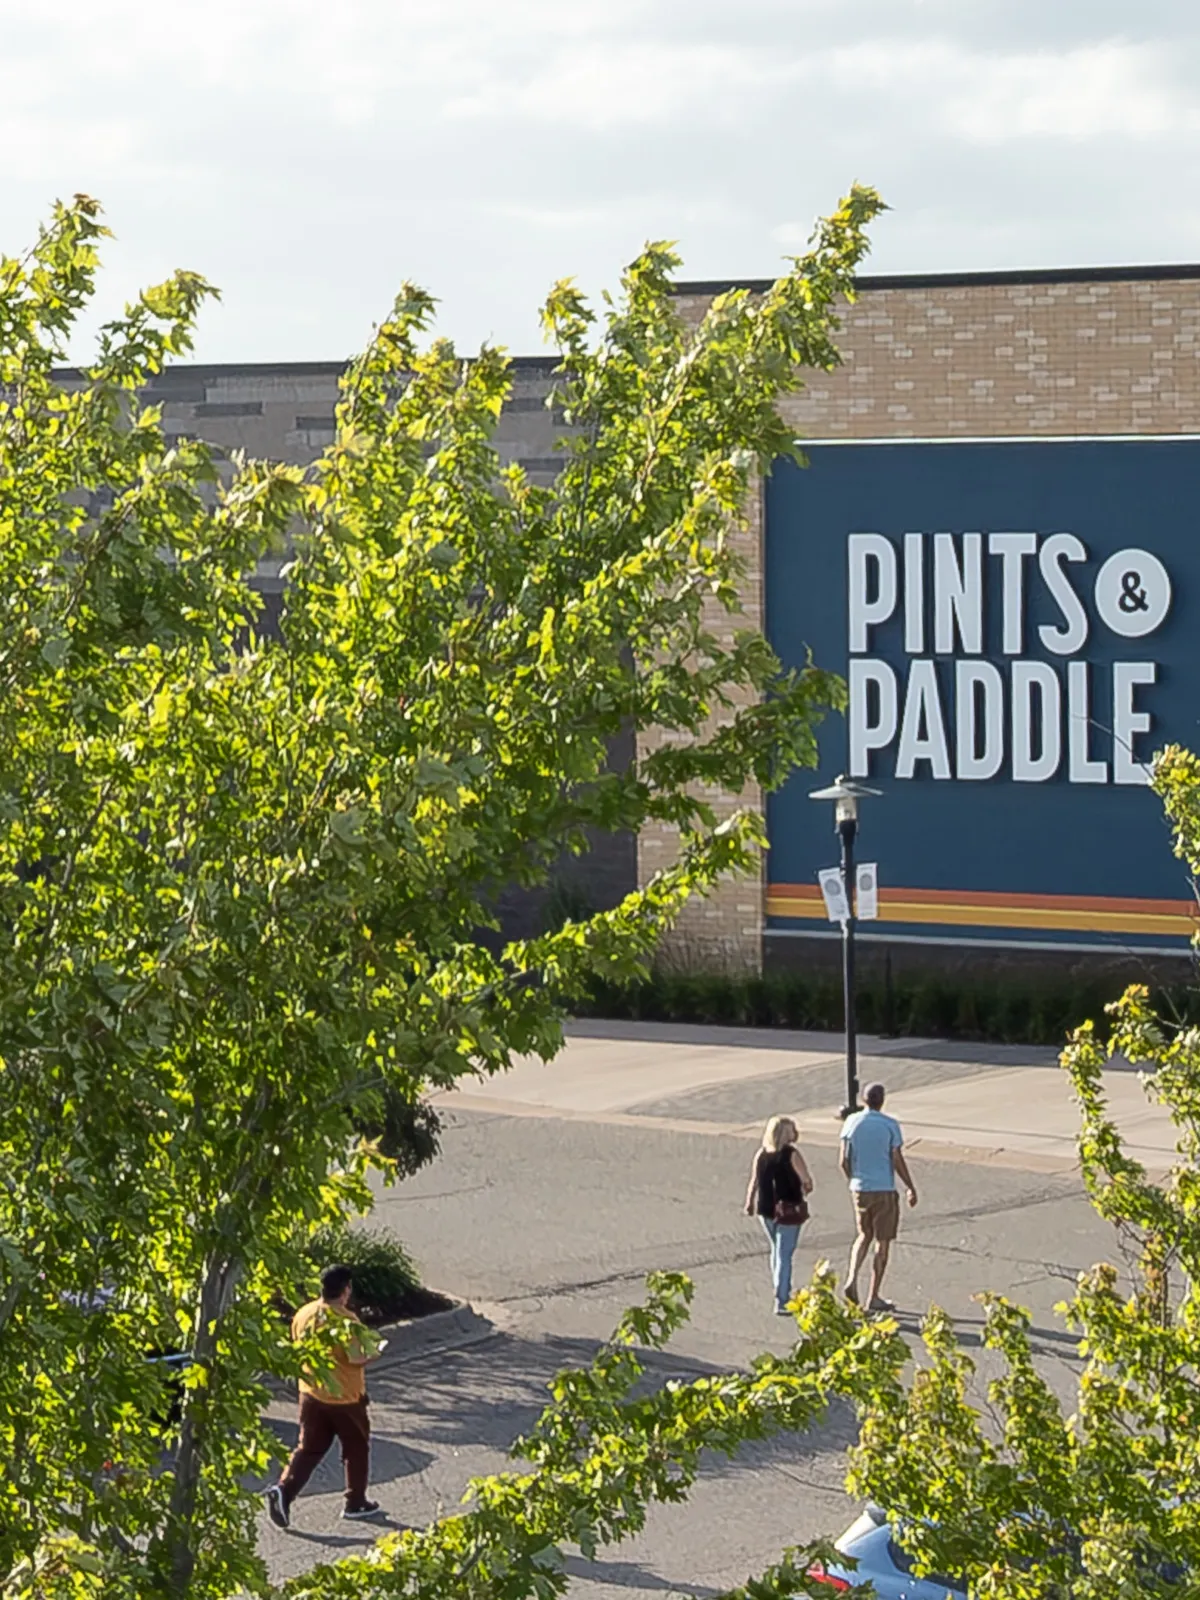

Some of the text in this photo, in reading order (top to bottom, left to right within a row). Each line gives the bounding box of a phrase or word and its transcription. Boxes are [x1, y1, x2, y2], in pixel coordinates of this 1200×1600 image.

[847, 532, 1150, 655] PINTS &
[848, 658, 1156, 784] PADDLE
